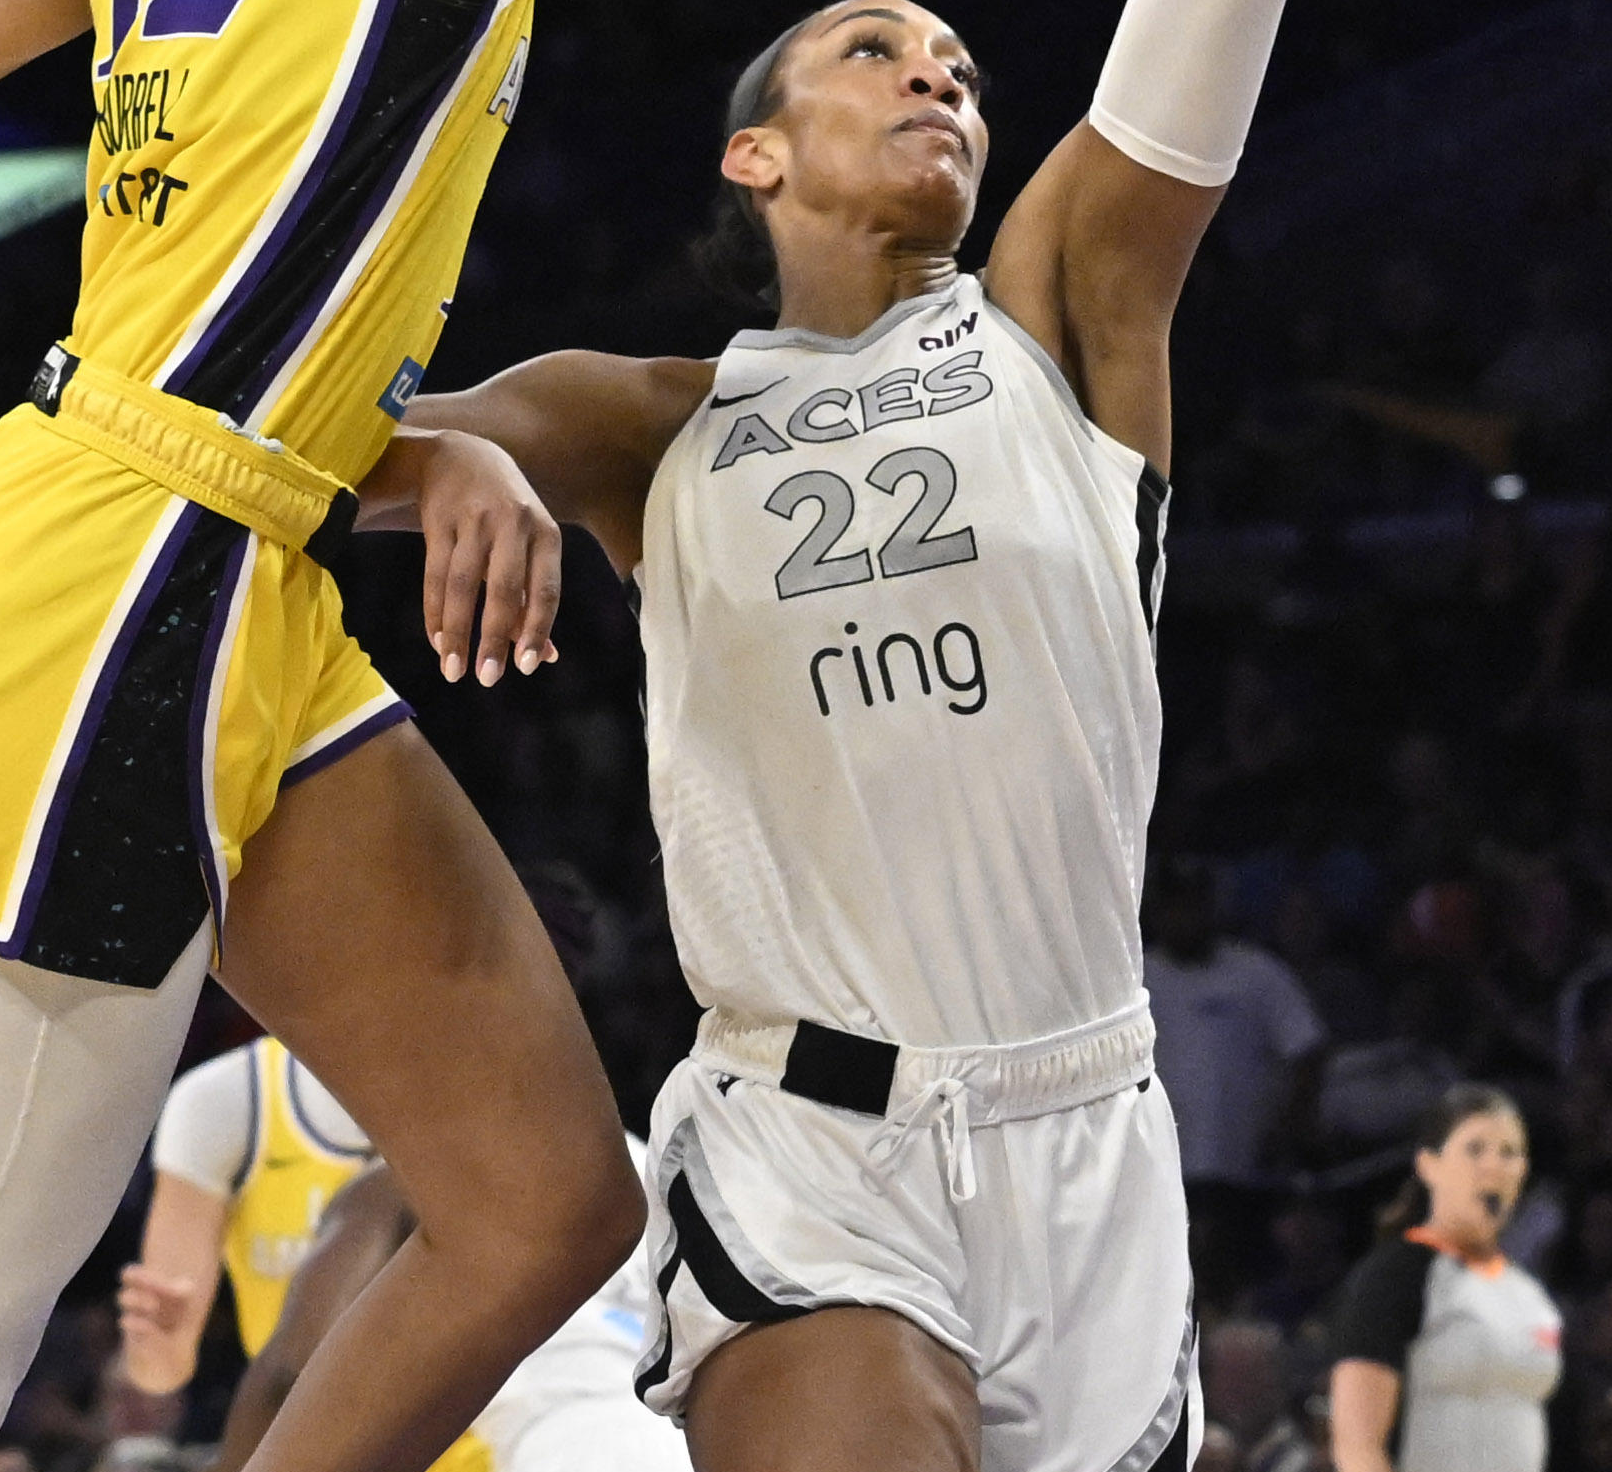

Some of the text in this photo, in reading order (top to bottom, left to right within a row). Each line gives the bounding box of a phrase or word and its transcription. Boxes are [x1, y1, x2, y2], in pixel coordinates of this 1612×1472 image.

[918, 311, 978, 351] ally
[709, 350, 993, 472] ACES
[763, 446, 978, 601] 22
[808, 621, 988, 716] ring
